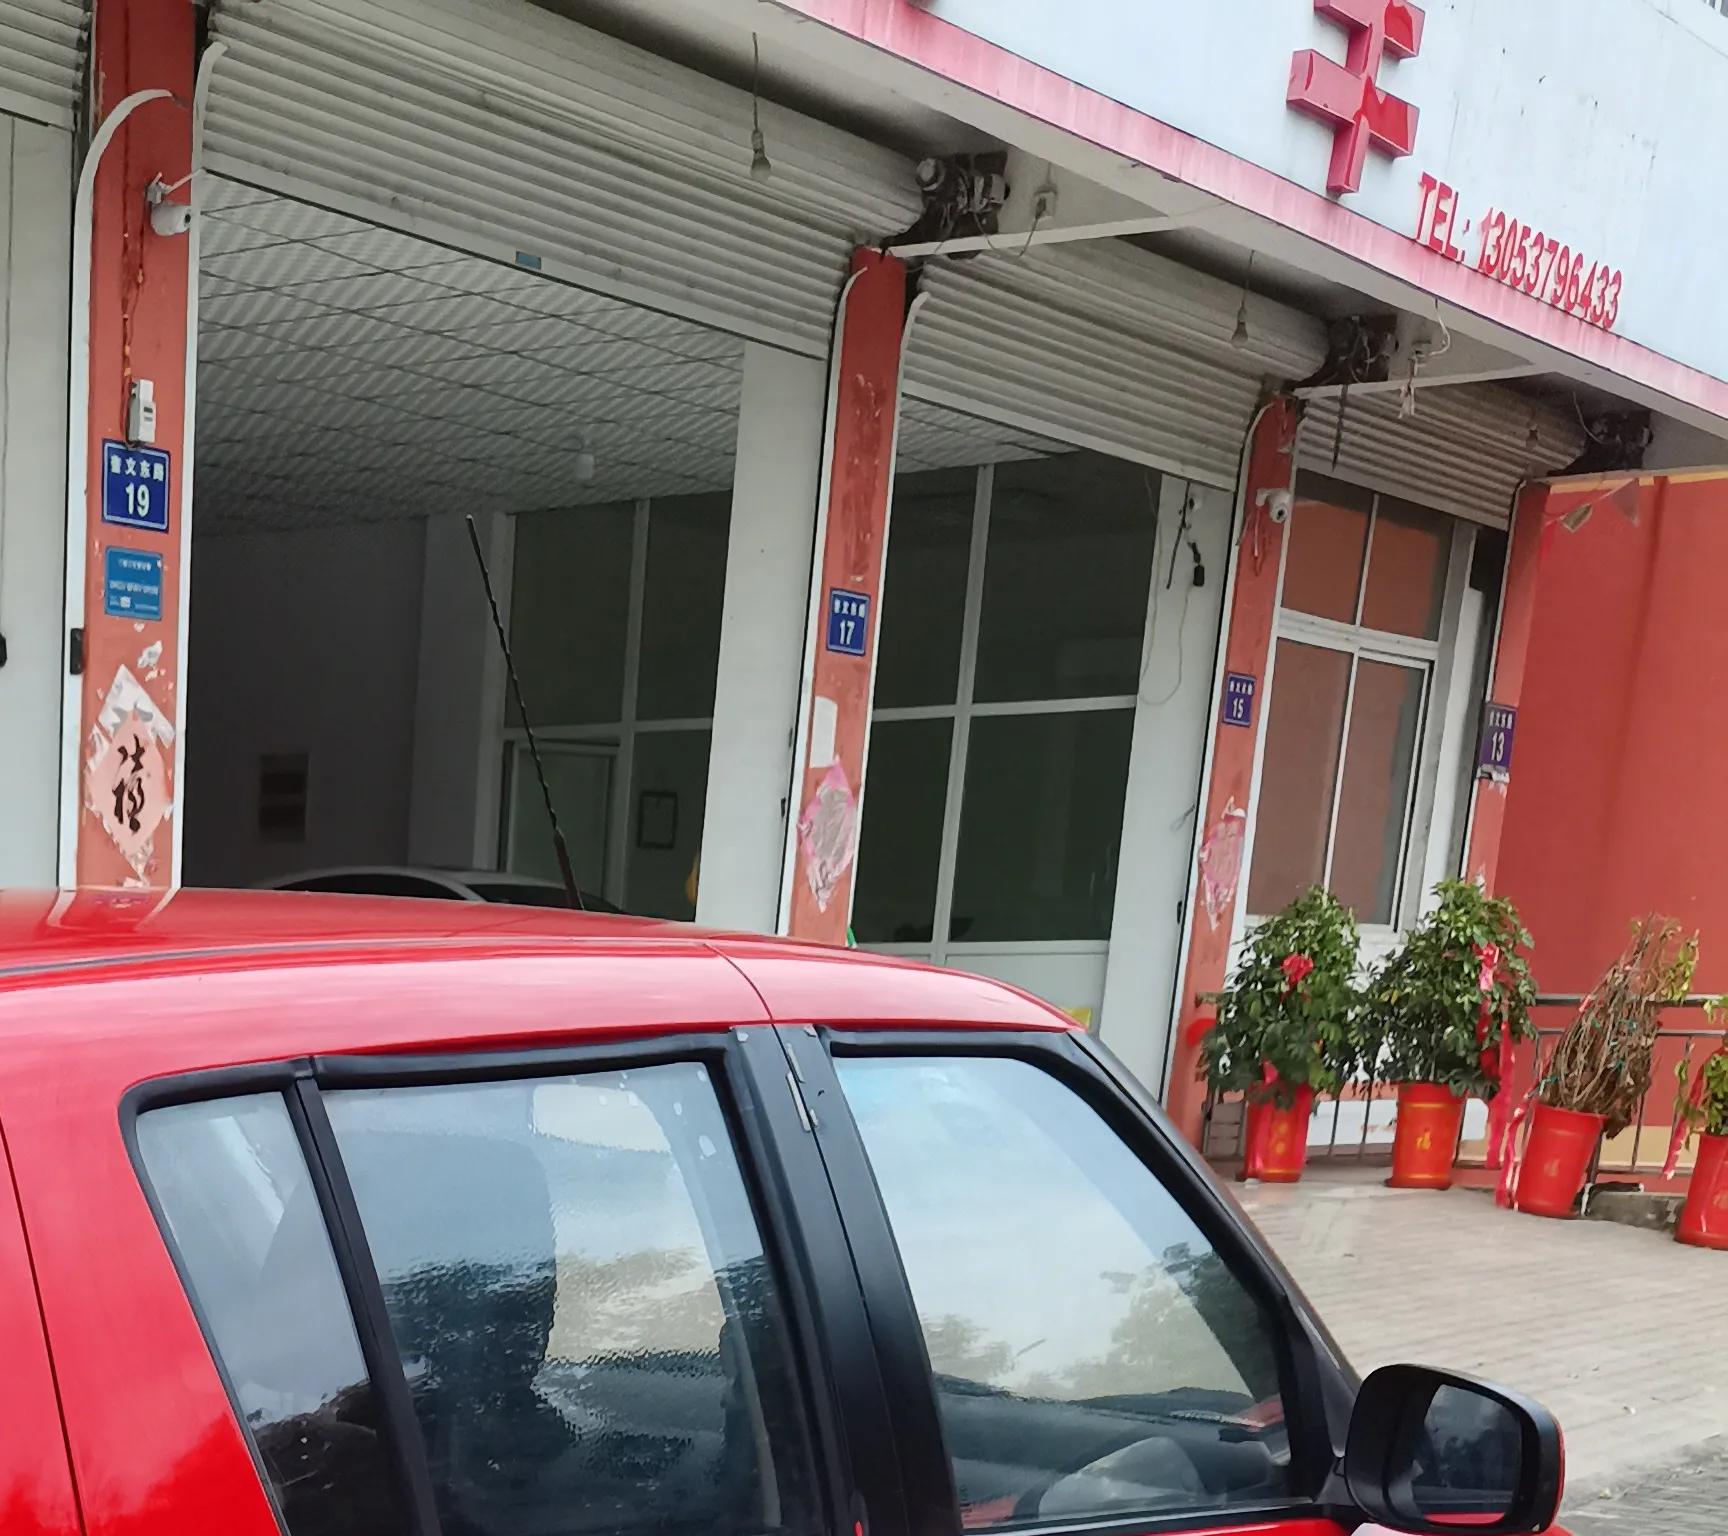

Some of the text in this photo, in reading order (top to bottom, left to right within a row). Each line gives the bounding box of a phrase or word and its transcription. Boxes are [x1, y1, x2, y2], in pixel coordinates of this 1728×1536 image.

[1477, 206, 1622, 330] 13053796433
[125, 481, 150, 518] 19
[839, 618, 856, 646] 17
[1232, 698, 1245, 719] 15
[1490, 731, 1506, 762] 13
